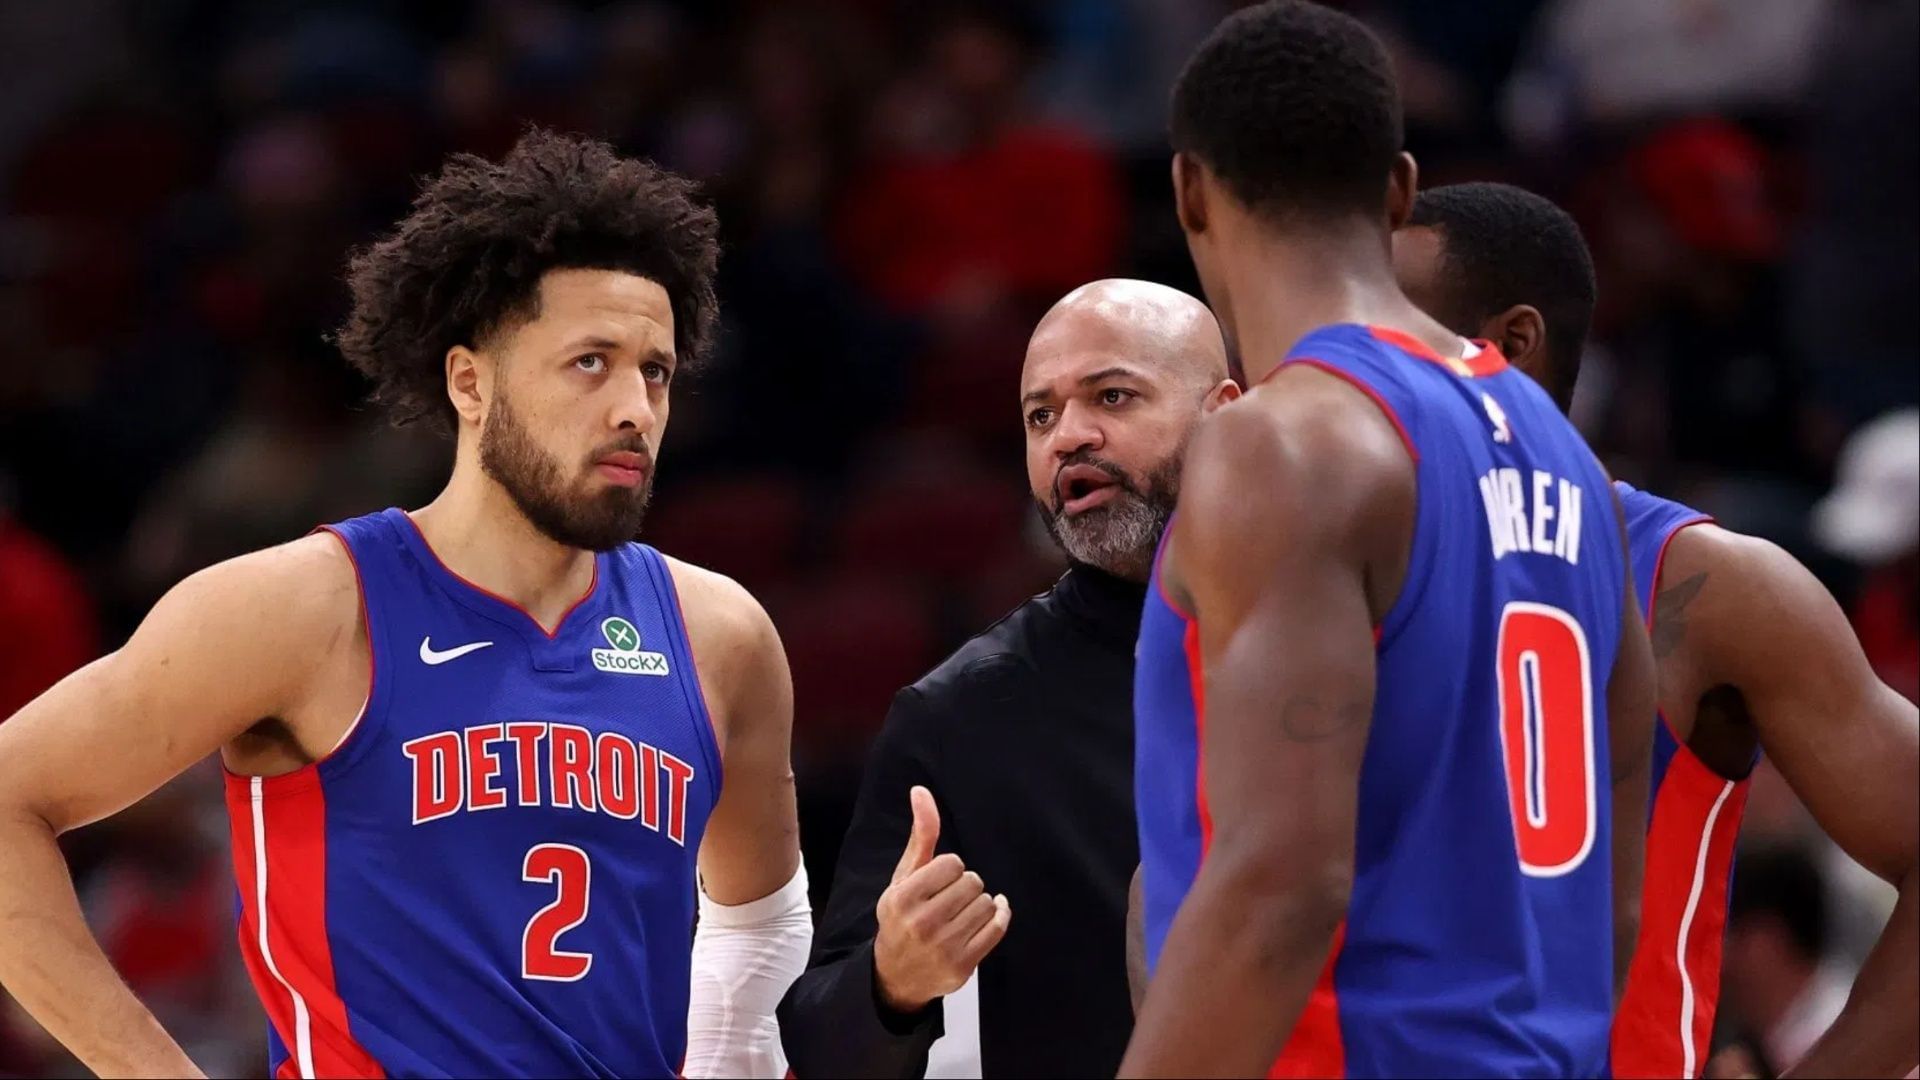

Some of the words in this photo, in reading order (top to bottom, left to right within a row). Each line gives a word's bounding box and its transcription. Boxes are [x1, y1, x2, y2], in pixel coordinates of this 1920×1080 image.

[595, 652, 666, 672] StockX
[402, 722, 694, 847] DETROIT
[1496, 601, 1596, 877] 0
[522, 843, 593, 982] 2
